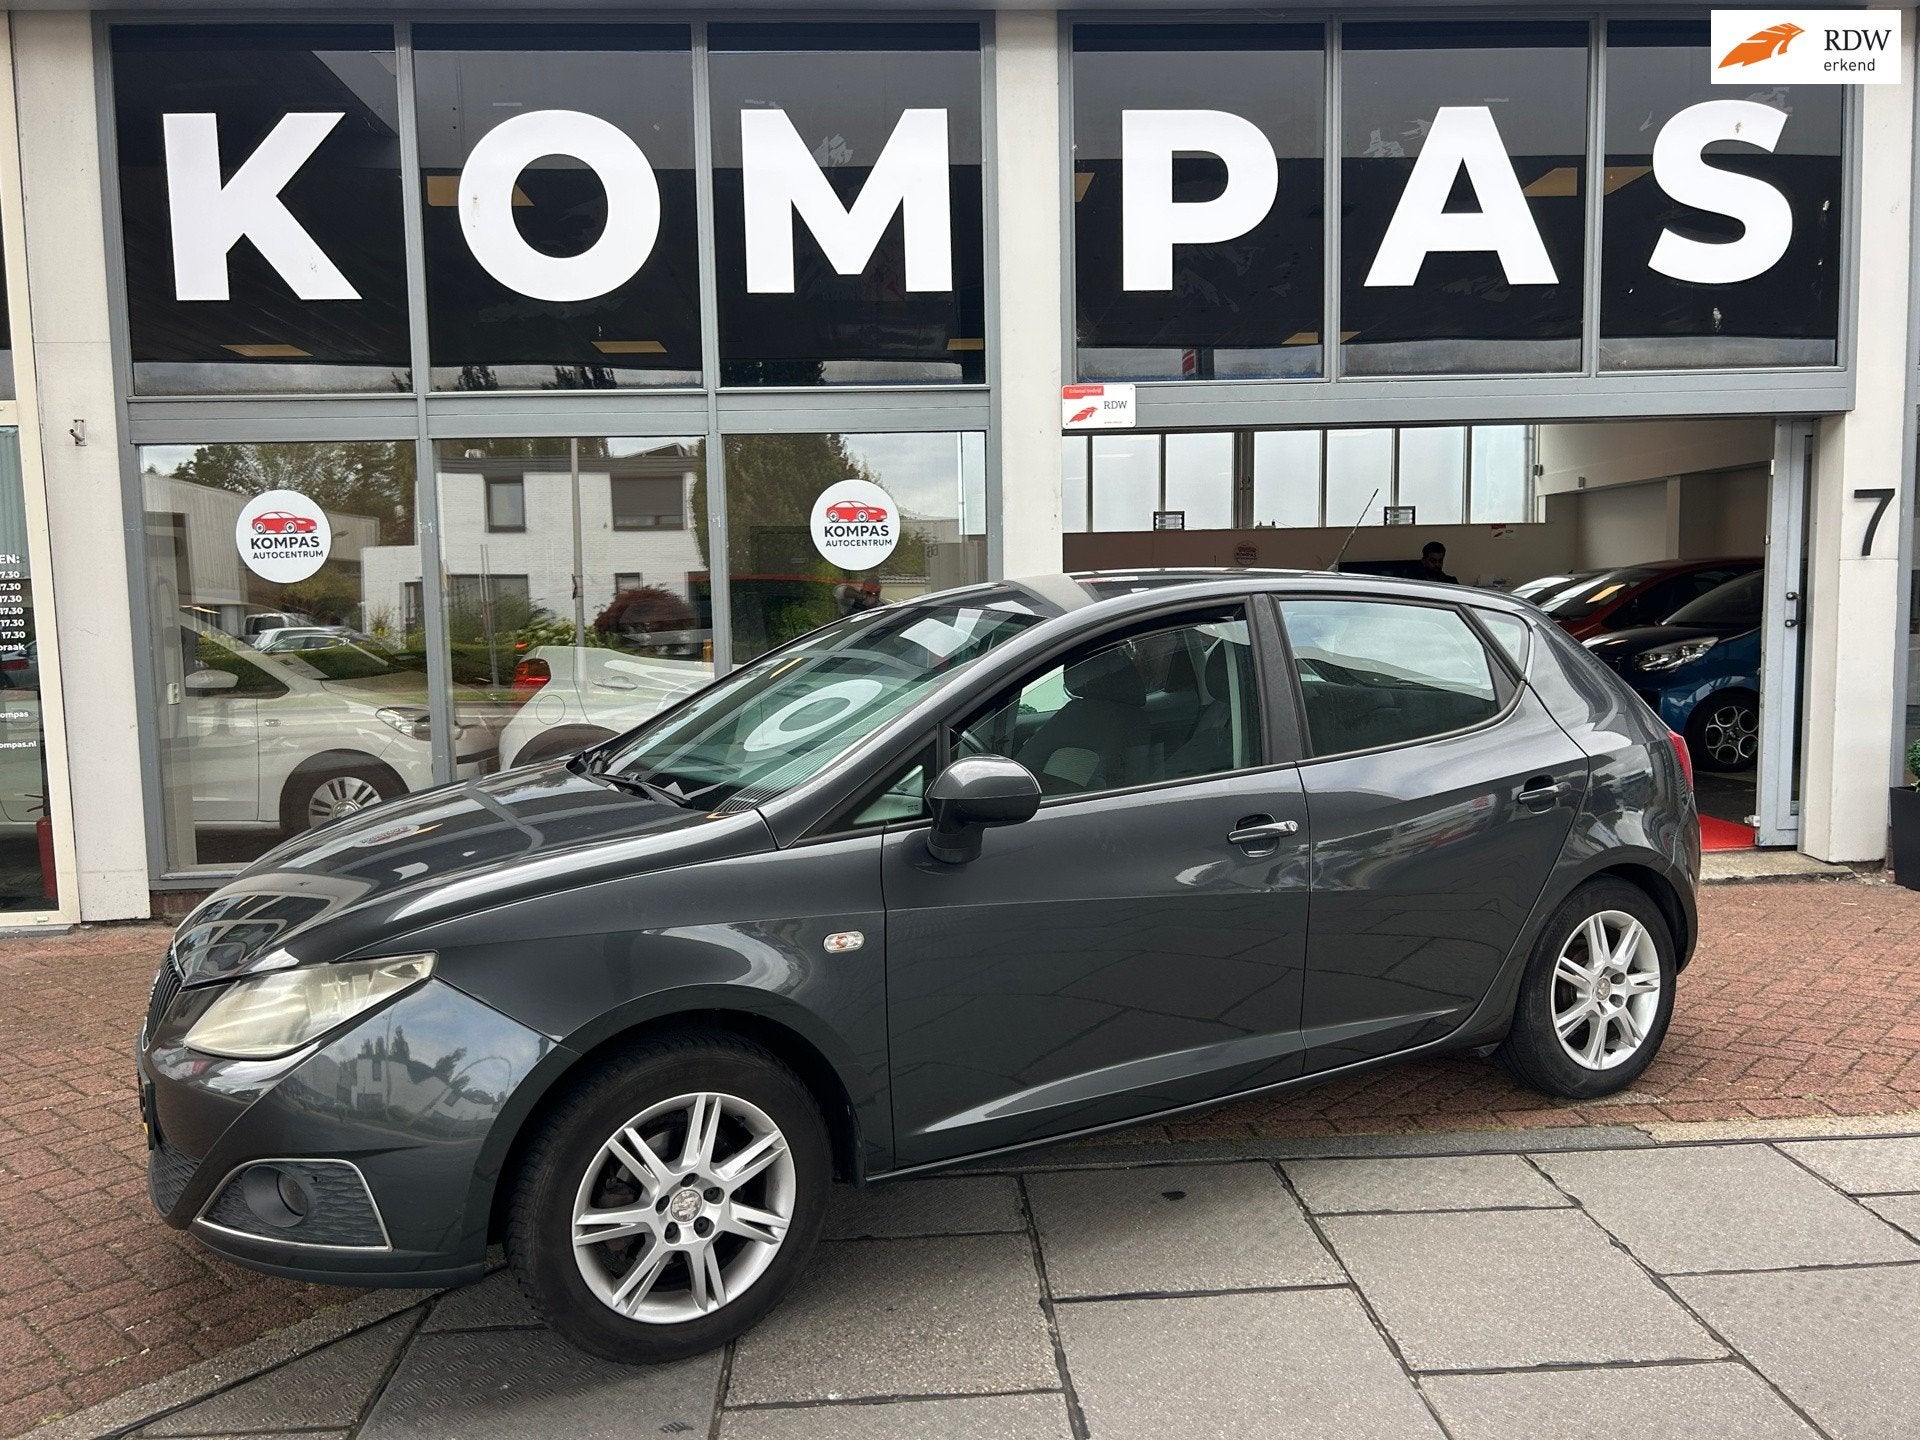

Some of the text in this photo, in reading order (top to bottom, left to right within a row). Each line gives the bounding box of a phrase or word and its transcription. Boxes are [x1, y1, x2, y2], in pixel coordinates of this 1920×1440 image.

[1103, 400, 1128, 410] RDW
[1854, 488, 1895, 556] 7
[824, 525, 889, 537] KOMPAS
[250, 536, 320, 549] KOMPAS
[825, 539, 892, 547] AUTOCENTRUM
[252, 550, 324, 559] AUTOCENTRUM
[0, 607, 23, 615] 17.30
[1, 631, 26, 639] 17.30
